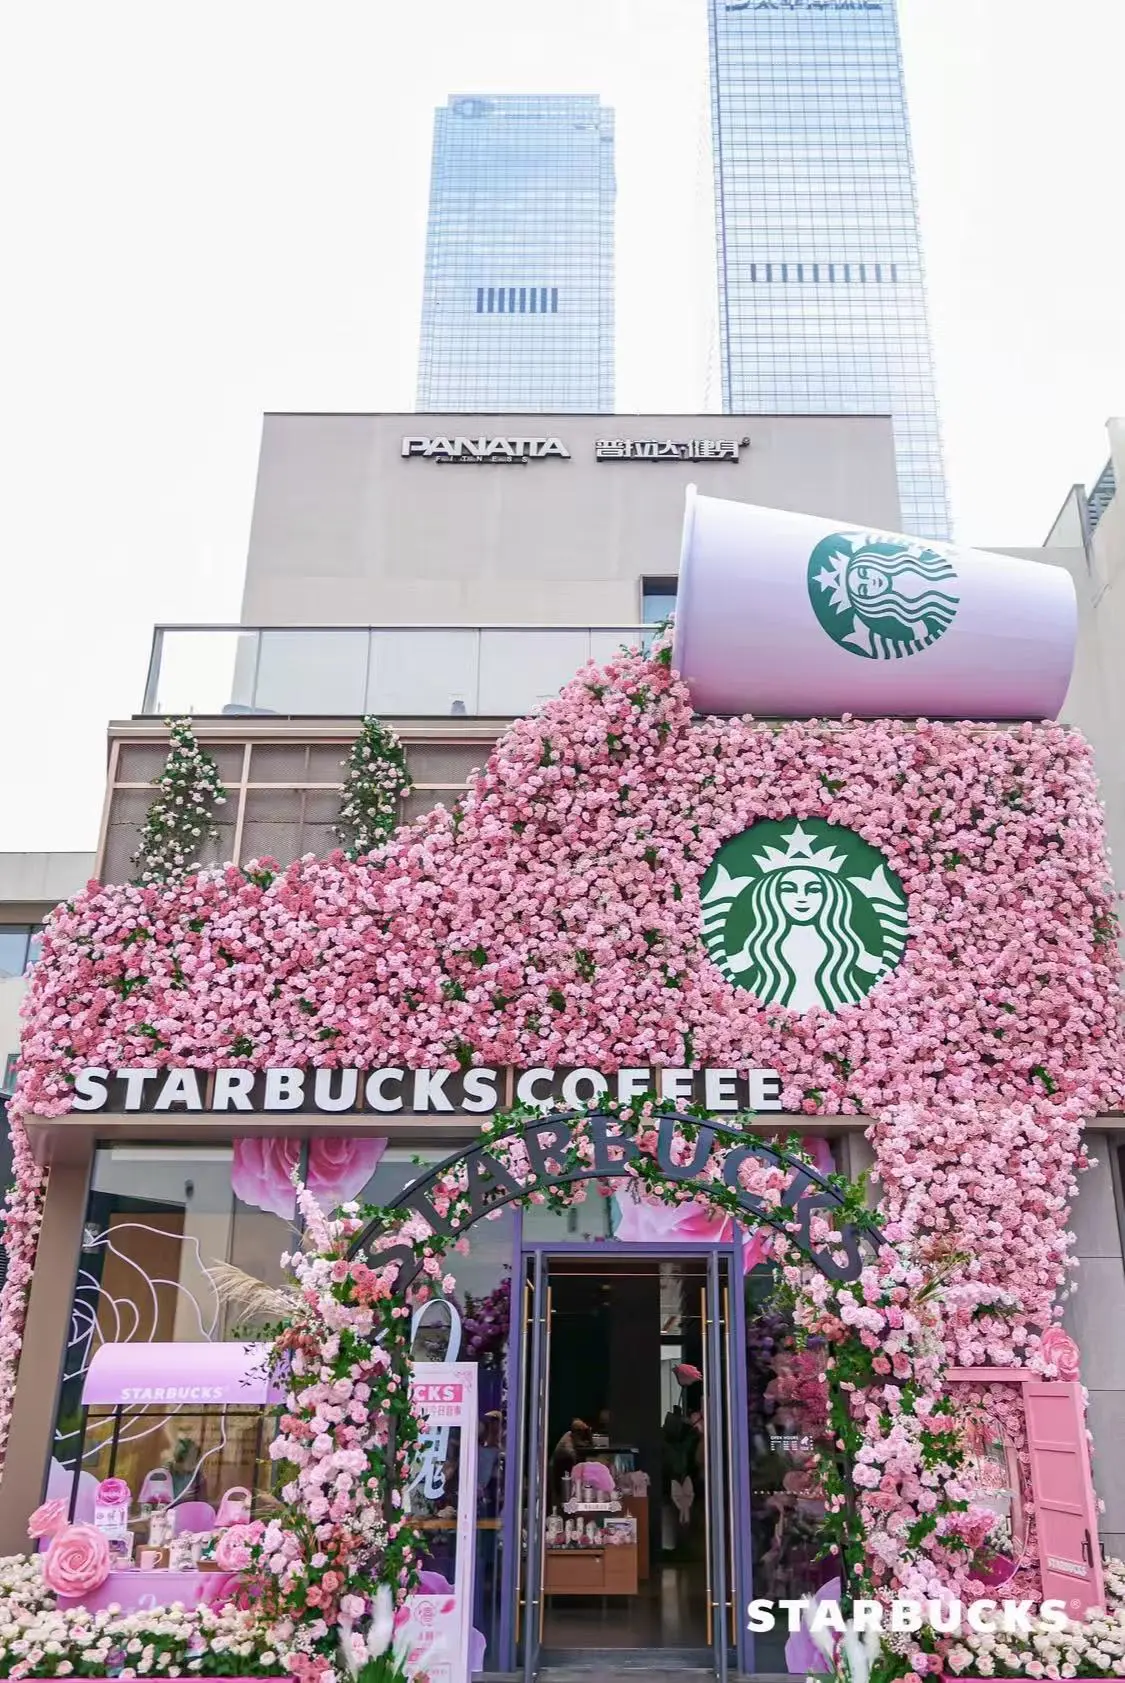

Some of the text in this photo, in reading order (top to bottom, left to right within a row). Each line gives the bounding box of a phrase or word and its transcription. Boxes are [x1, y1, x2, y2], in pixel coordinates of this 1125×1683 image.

[401, 436, 571, 458] PANATTA
[435, 455, 529, 463] FITNESS
[71, 1066, 782, 1112] STARBUCKS COFFEE
[121, 1386, 223, 1400] STARBUCKS
